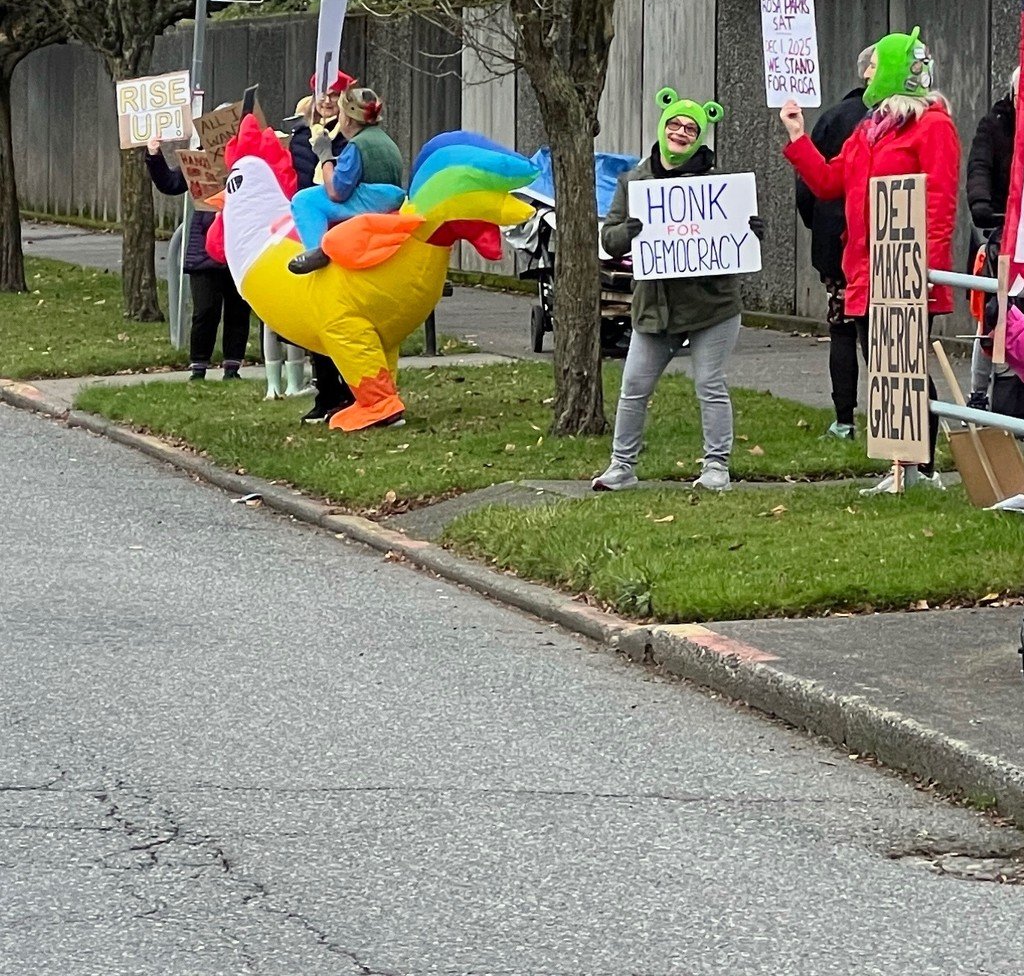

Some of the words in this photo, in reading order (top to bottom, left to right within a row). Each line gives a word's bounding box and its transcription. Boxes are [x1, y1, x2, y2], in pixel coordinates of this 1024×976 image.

[773, 15, 795, 31] SAT
[788, 37, 812, 57] 2025
[767, 57, 781, 74] WE
[785, 57, 816, 75] STAND
[120, 78, 187, 114] RISE
[767, 74, 788, 93] FOR
[789, 75, 817, 96] ROSA
[132, 109, 182, 141] UP!
[201, 115, 226, 135] ALL
[206, 122, 238, 147] WAN
[646, 183, 728, 224] HONK
[876, 178, 916, 241] DEI
[667, 224, 701, 236] FOR
[640, 232, 749, 276] DEMOCRACY
[871, 241, 923, 300] MAKES
[869, 306, 926, 375] AMERICA
[869, 376, 925, 442] GREAT
